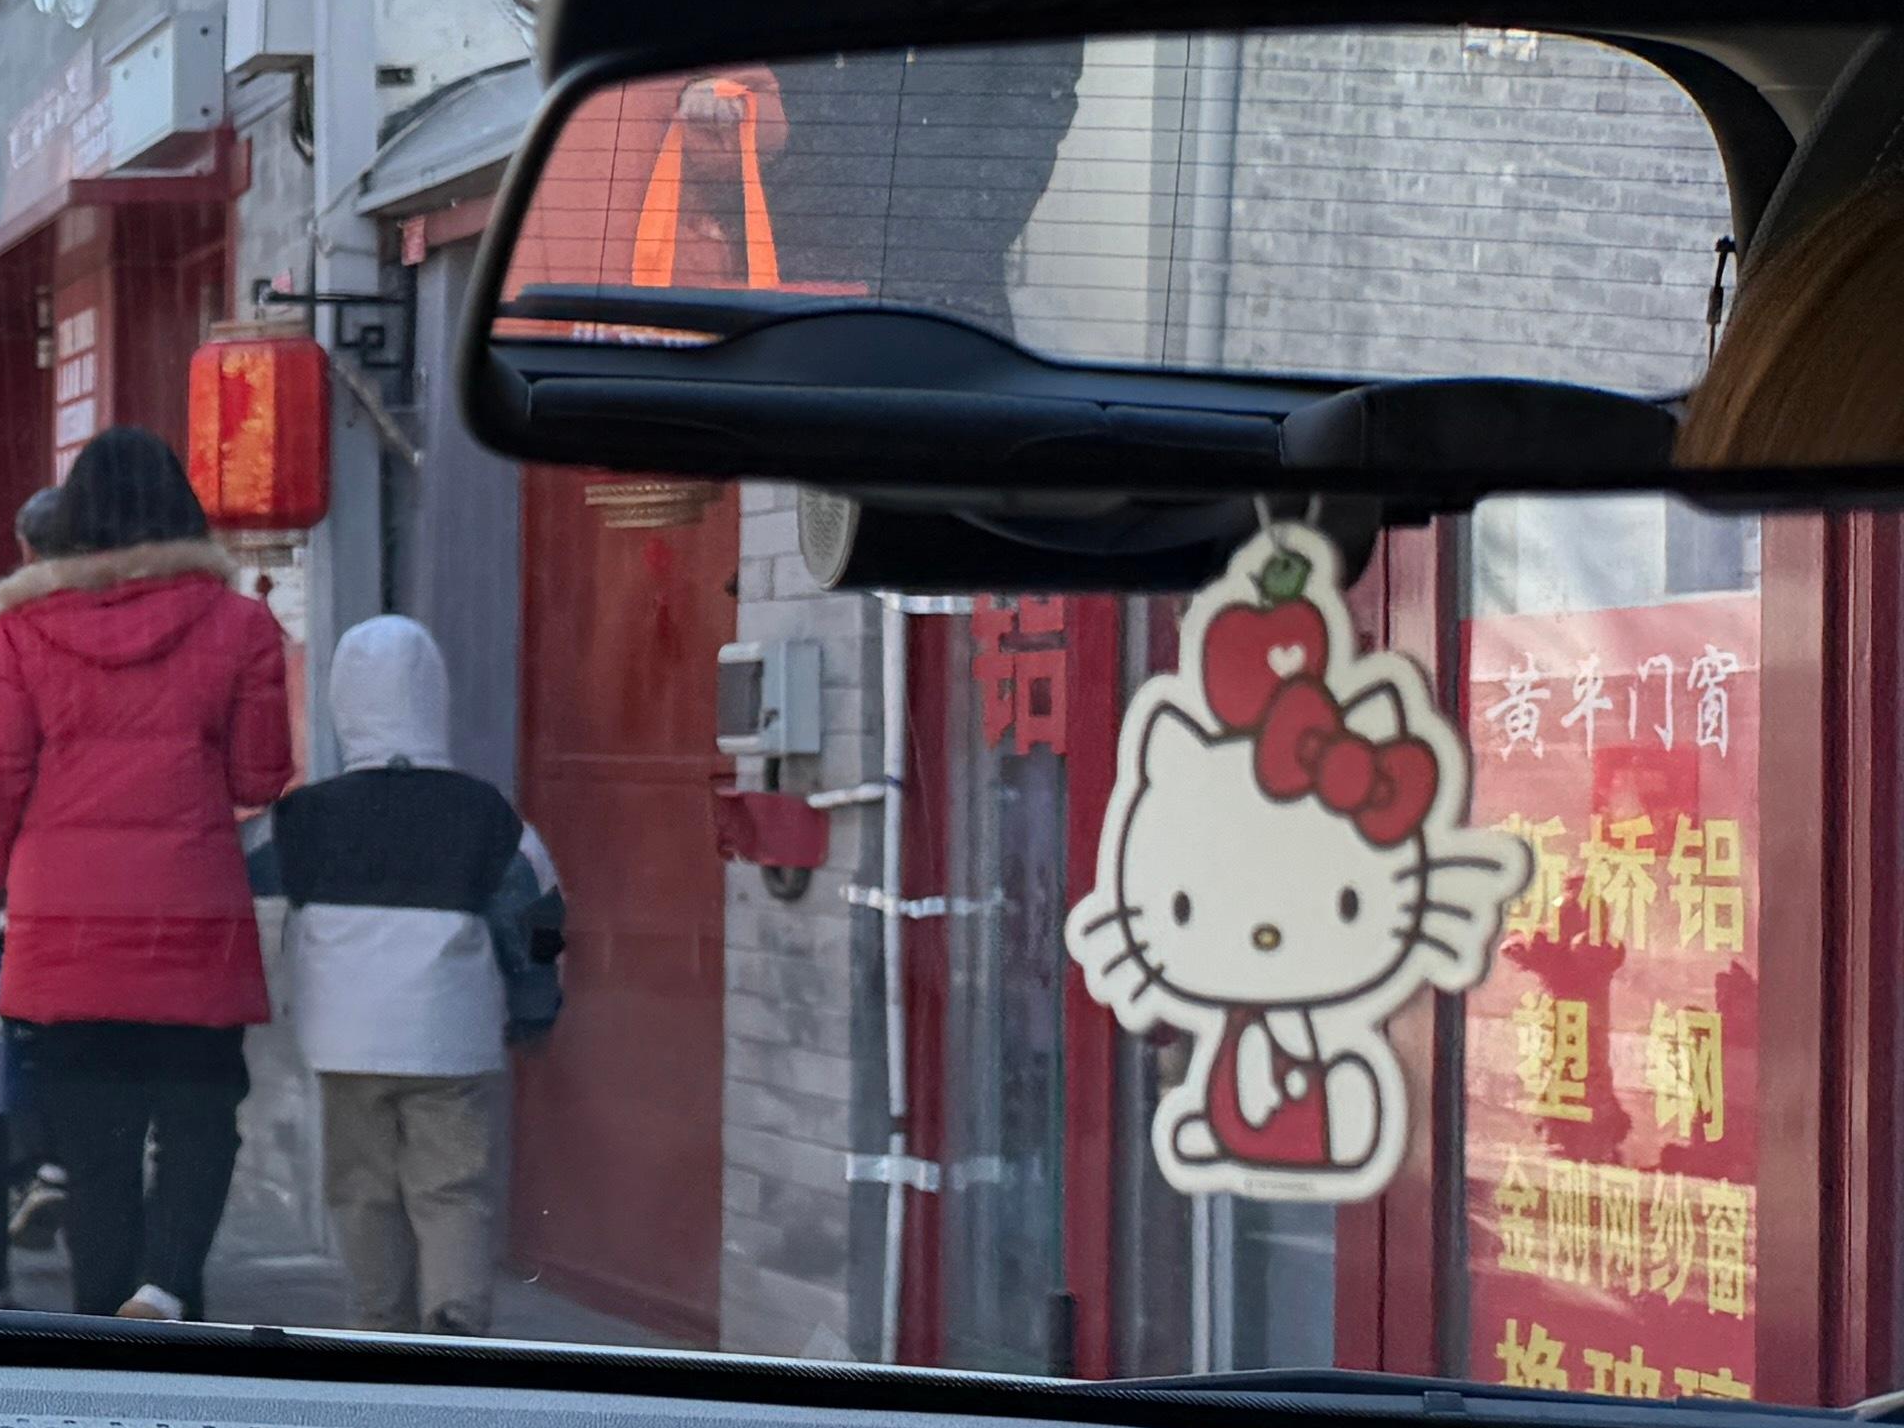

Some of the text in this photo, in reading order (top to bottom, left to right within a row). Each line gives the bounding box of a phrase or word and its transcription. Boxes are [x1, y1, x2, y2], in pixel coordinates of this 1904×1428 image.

[1490, 812, 1744, 952] 断桥铝
[1511, 990, 1724, 1143] 塑钢
[1494, 1146, 1748, 1321] 金刚网纱窗
